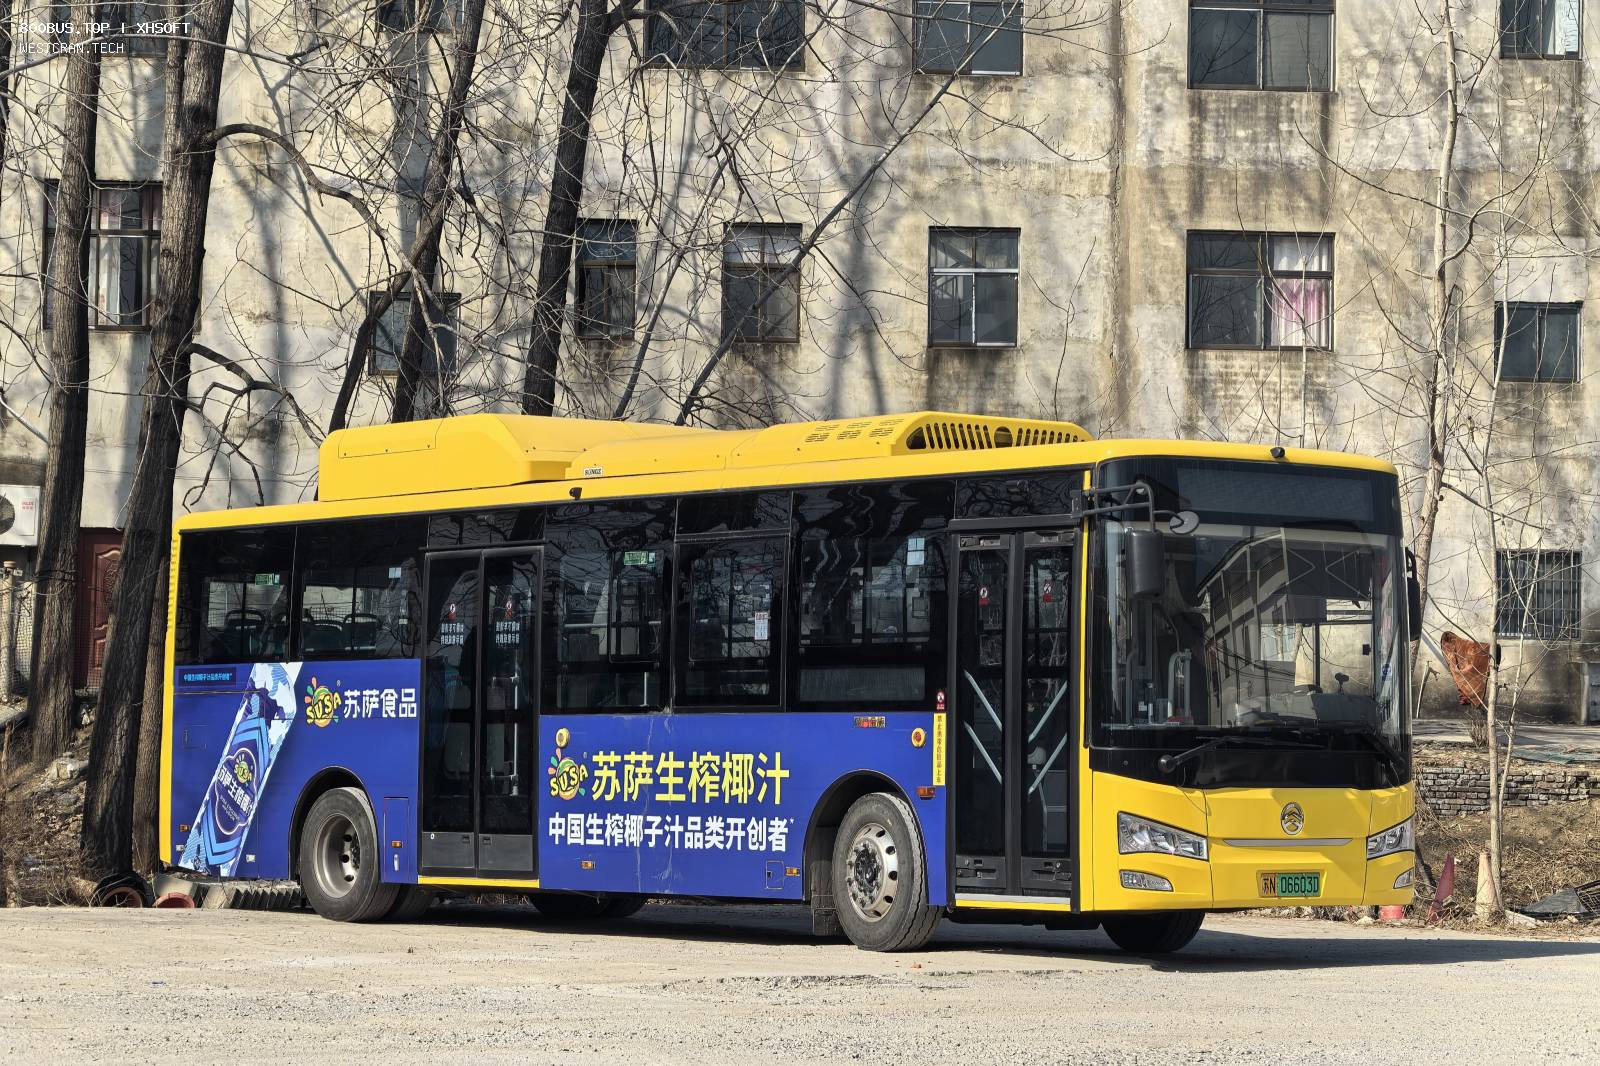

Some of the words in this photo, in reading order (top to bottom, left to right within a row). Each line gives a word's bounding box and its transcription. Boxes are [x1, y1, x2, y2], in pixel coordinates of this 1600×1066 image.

[306, 692, 342, 724] SUSA
[343, 688, 417, 718] 苏萨食品
[550, 764, 588, 796] SUSA
[591, 751, 790, 805] 苏萨生榨椰汁
[548, 812, 789, 852] 中国生榨椰子汁品类开创者
